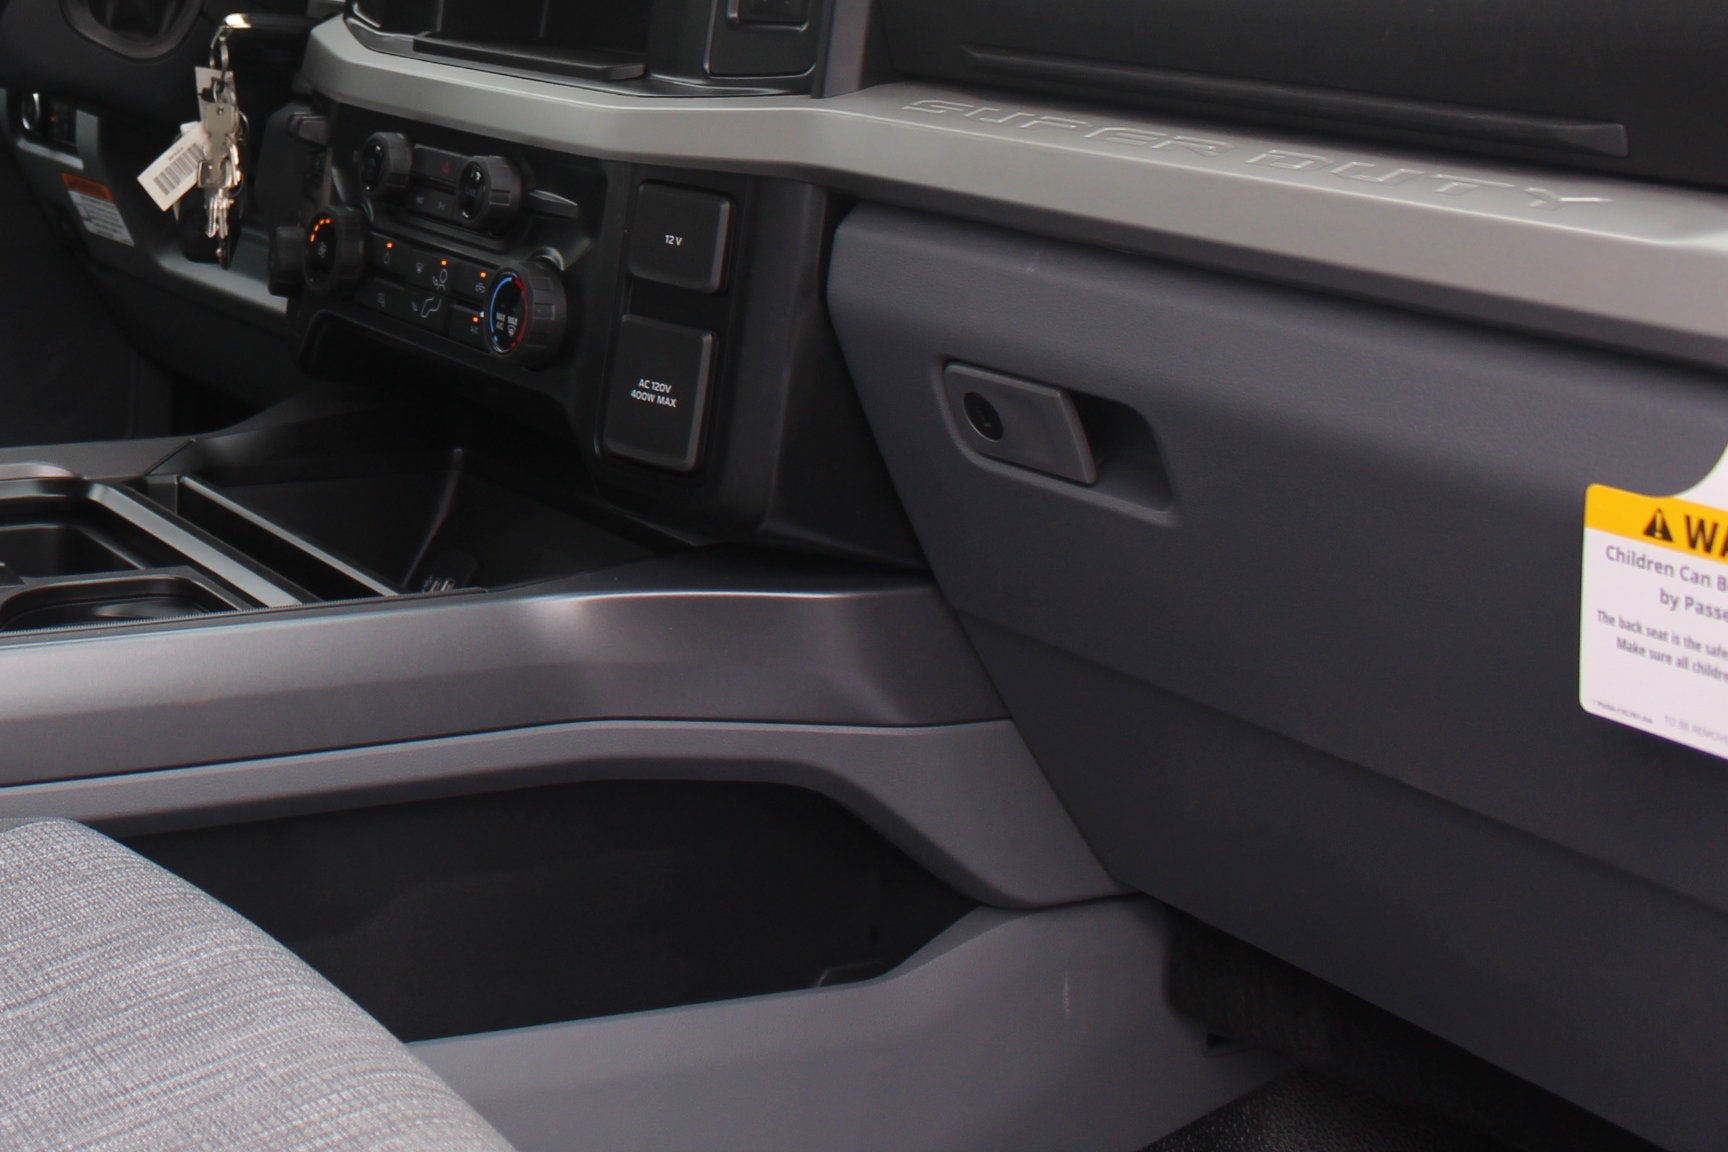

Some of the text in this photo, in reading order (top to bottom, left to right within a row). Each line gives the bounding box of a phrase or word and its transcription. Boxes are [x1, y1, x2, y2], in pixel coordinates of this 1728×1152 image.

[901, 99, 1615, 211] SUPER DUTY
[630, 389, 677, 407] 400W MAX
[638, 378, 672, 394] AC 120V
[1605, 545, 1728, 592] Children Can B
[1659, 587, 1679, 611] by
[1597, 609, 1616, 626] The
[1618, 615, 1643, 635] back
[1646, 627, 1669, 643] seat
[1671, 632, 1681, 646] is
[1683, 635, 1702, 653] the
[1616, 636, 1646, 656] Make
[1649, 649, 1672, 665] sure
[1675, 656, 1689, 670] all
